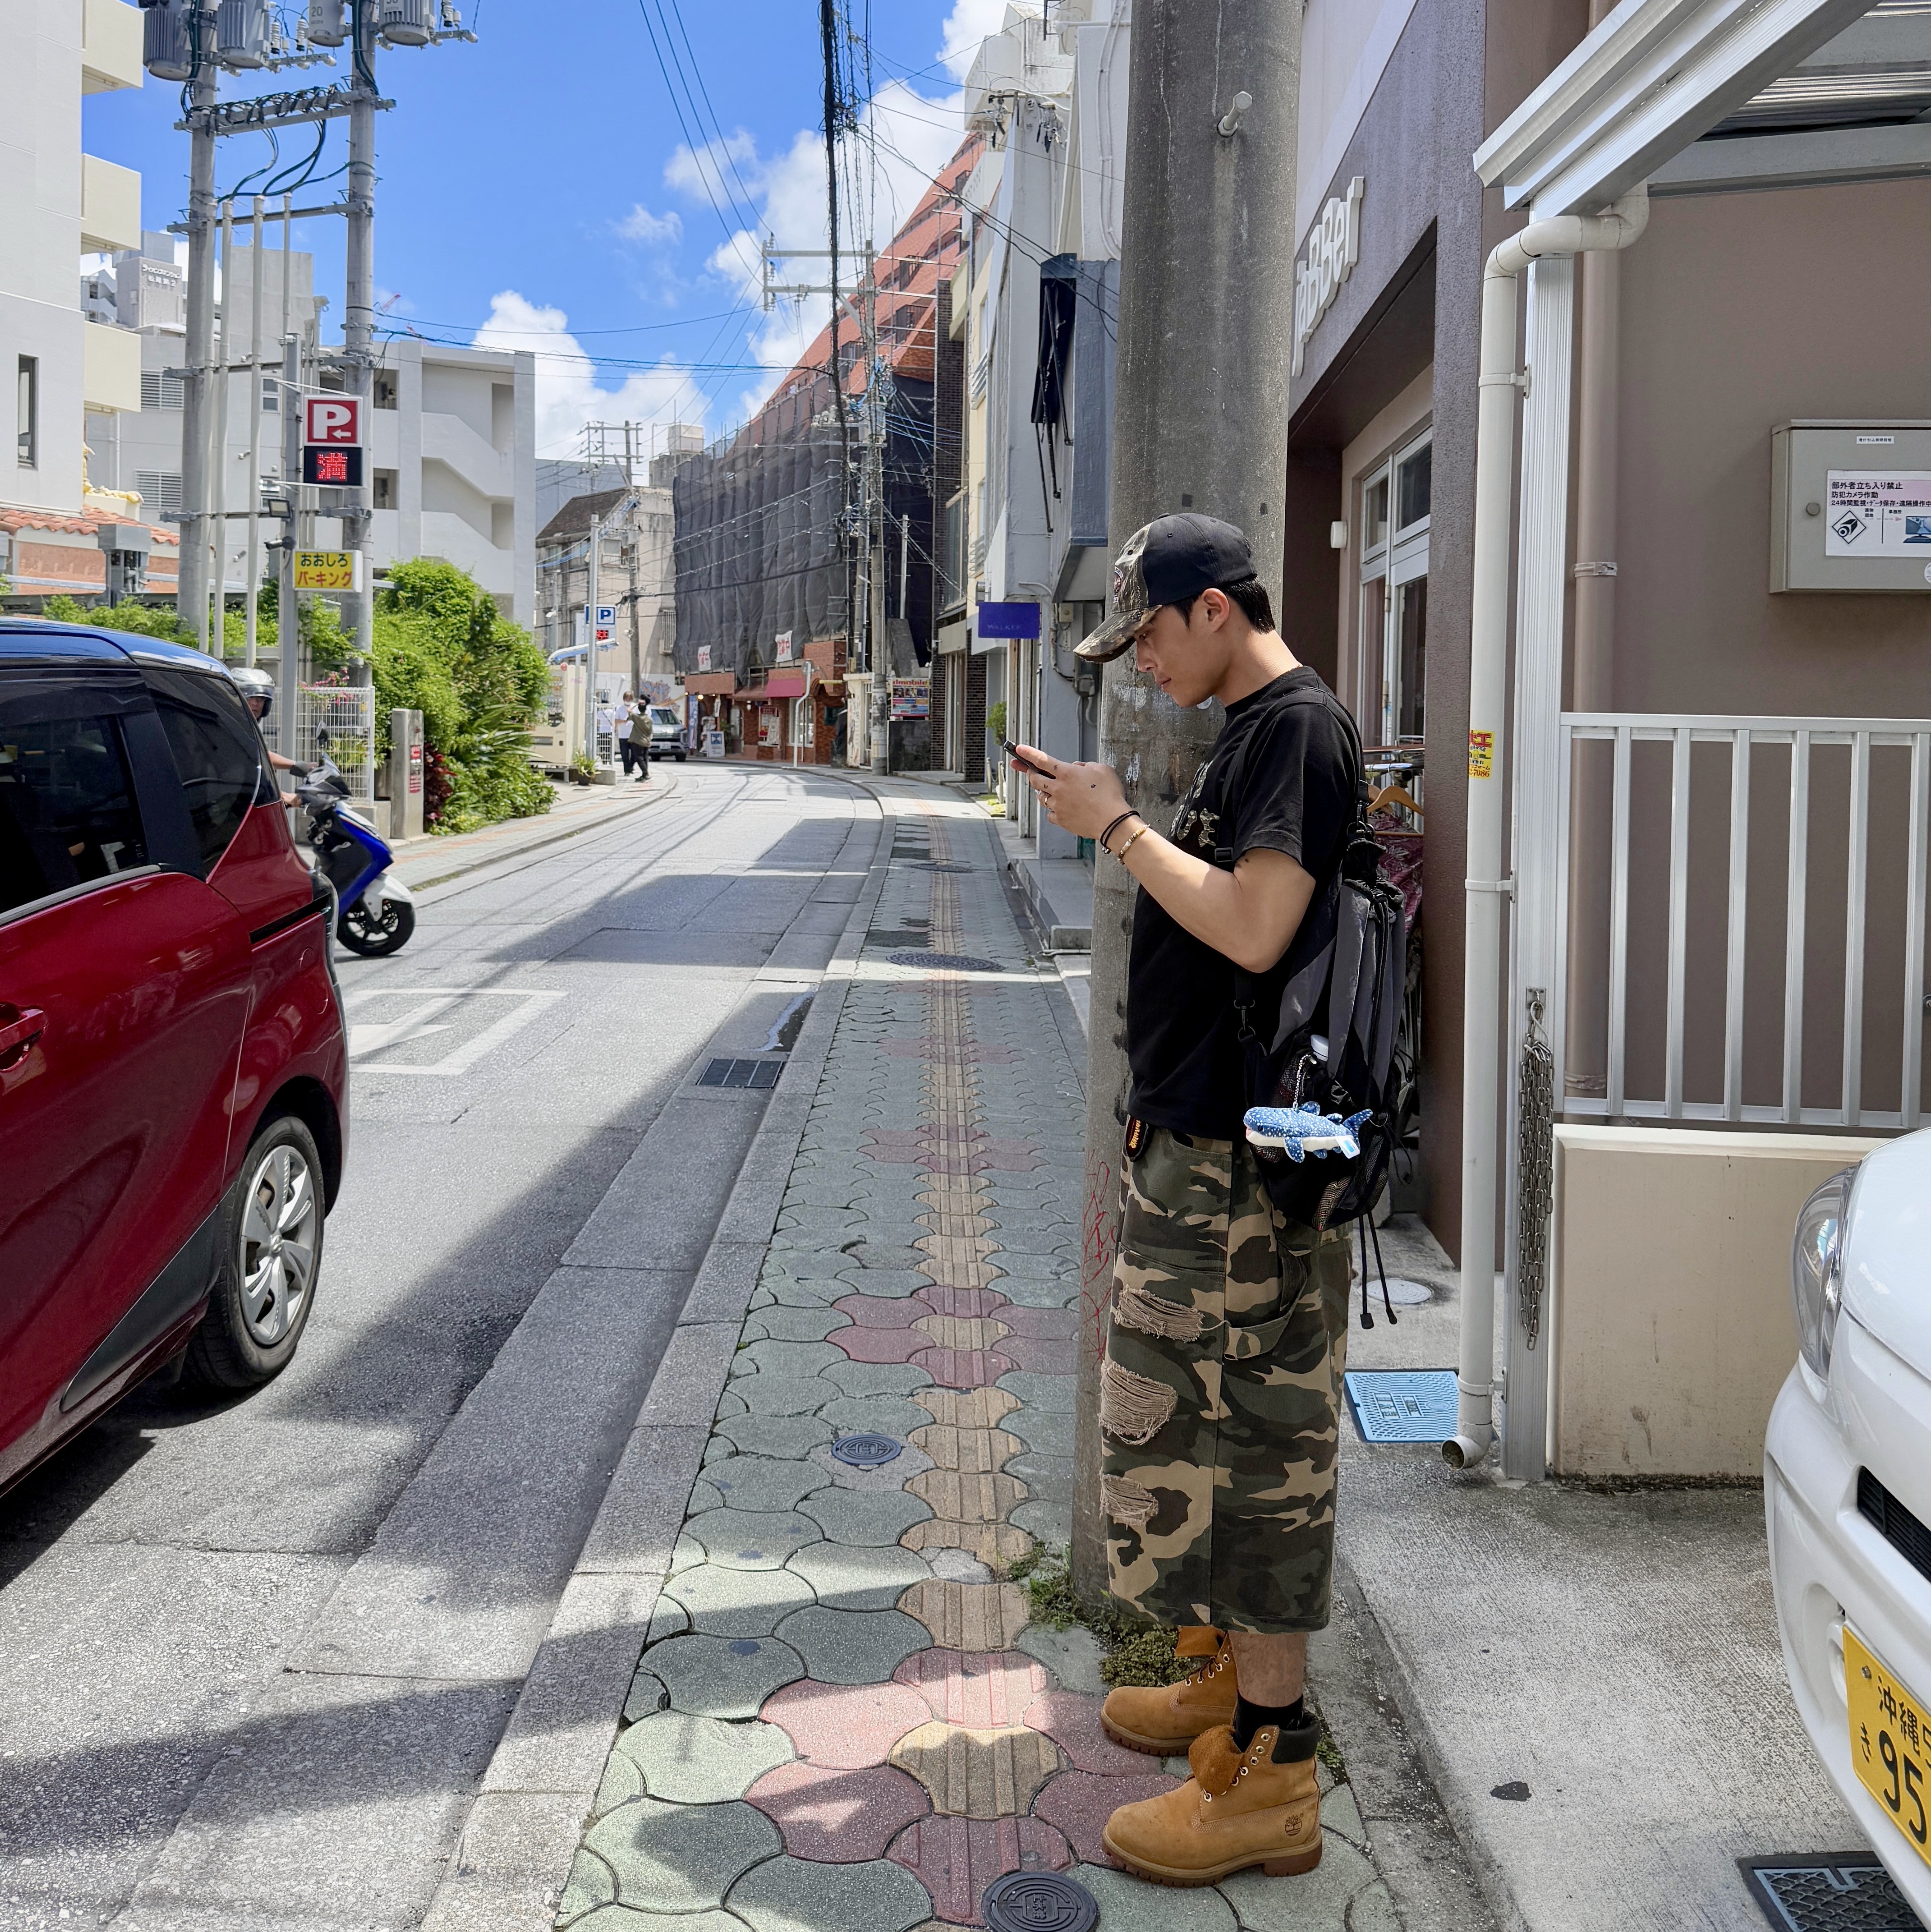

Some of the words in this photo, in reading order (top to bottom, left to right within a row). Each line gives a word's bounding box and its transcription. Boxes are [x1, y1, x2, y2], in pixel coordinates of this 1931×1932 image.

[312, 6, 322, 17] 20
[313, 404, 352, 439] P
[317, 452, 348, 481] 満
[1831, 482, 1903, 490] 部外者立ち入り禁止
[301, 553, 348, 568] おおしろ
[298, 571, 352, 587] パーキング
[600, 610, 611, 620] P
